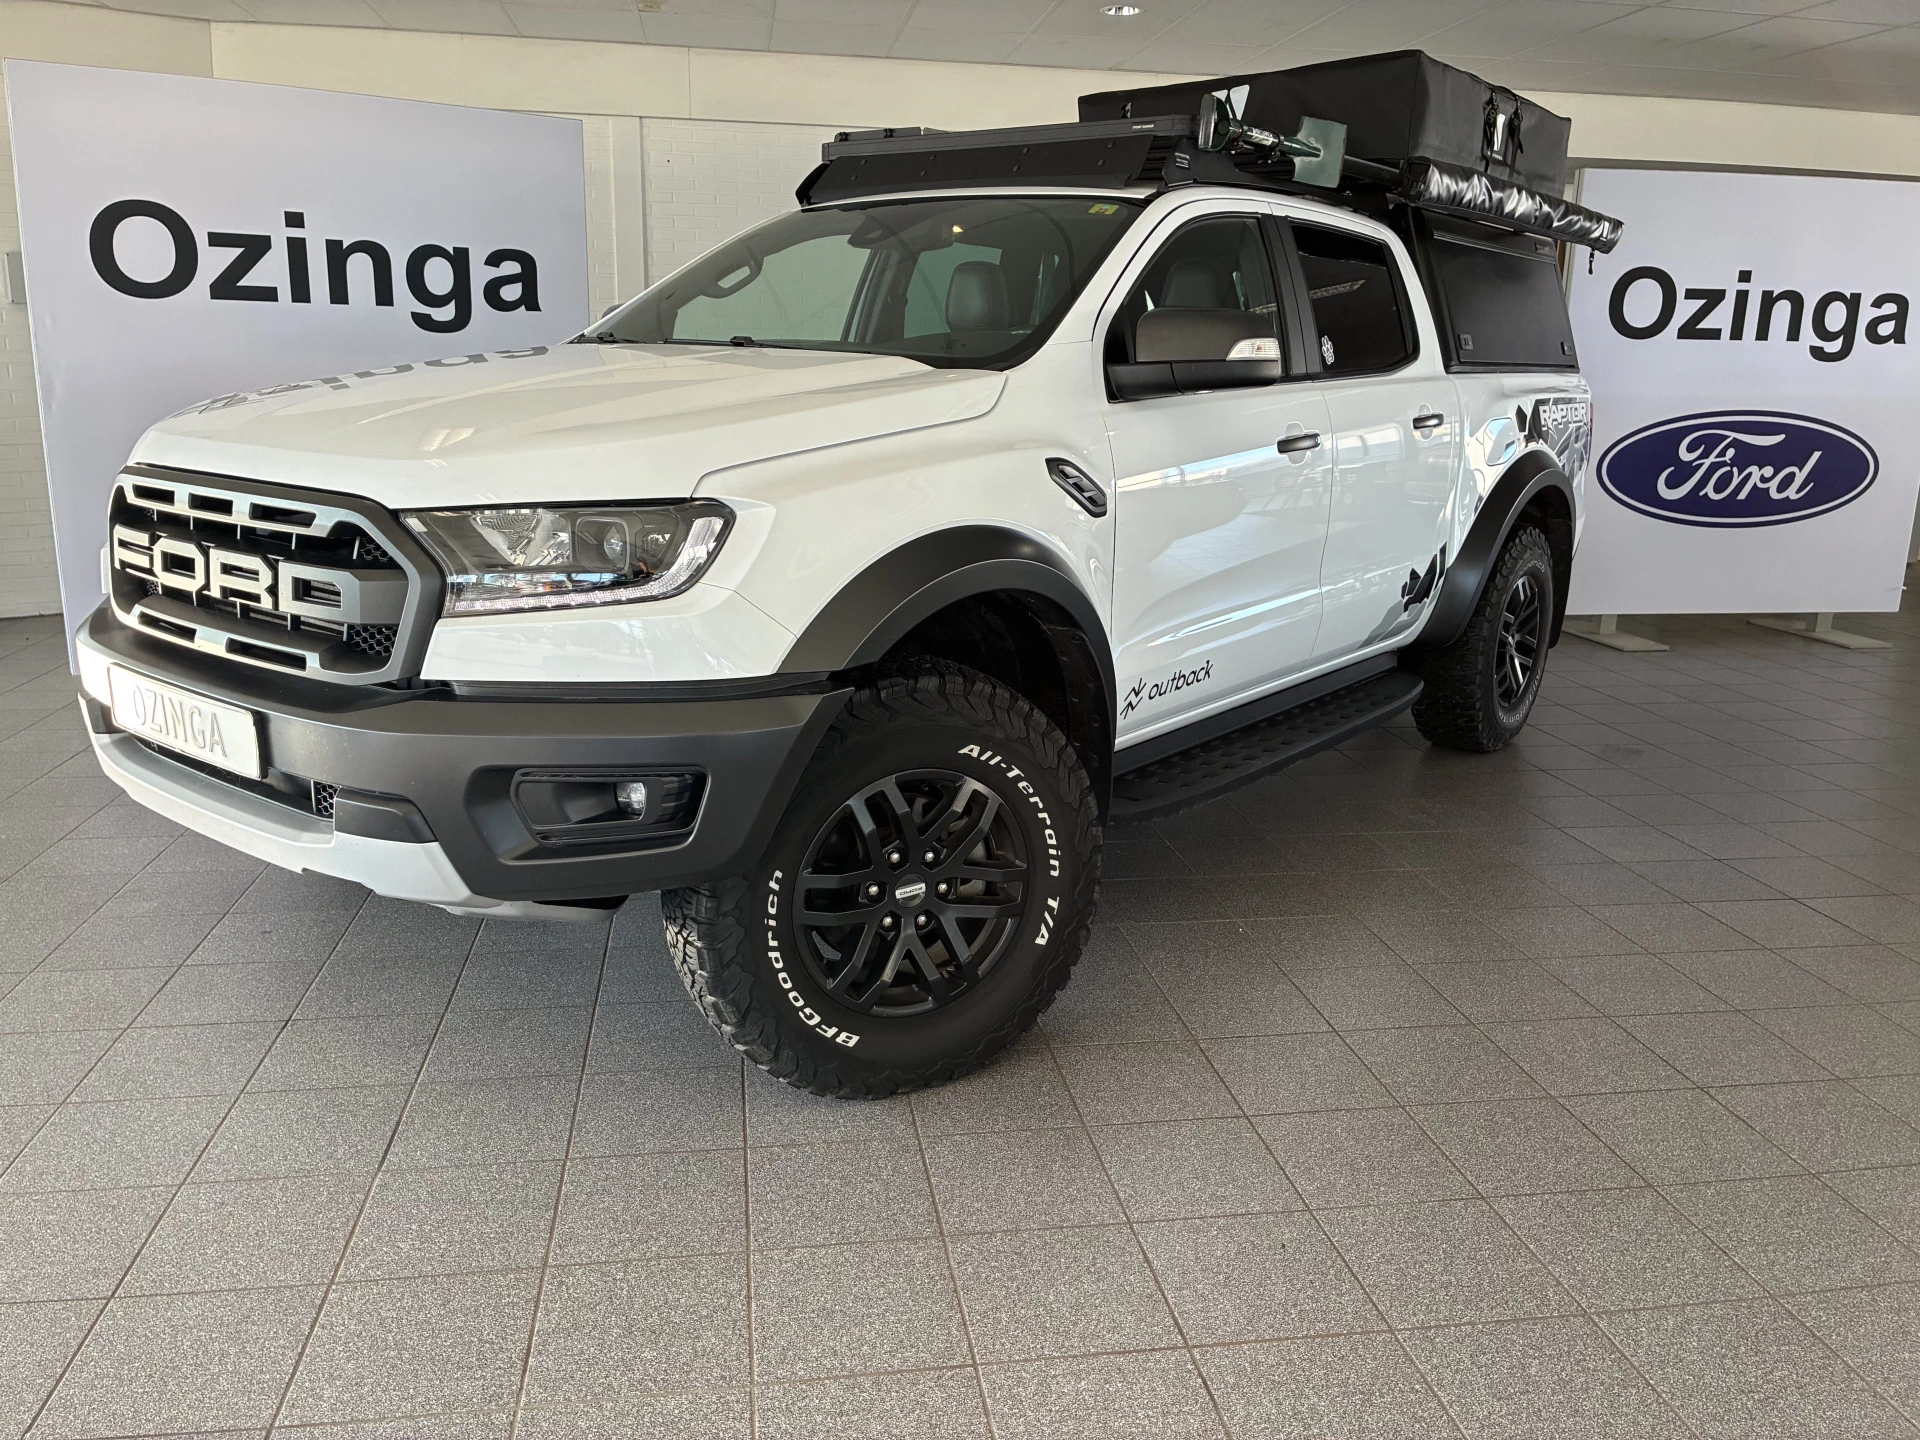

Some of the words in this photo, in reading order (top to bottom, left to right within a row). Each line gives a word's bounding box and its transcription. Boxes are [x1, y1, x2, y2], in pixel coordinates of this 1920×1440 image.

[89, 199, 542, 333] Ozinga
[1608, 265, 1910, 362] Ozinga
[1538, 402, 1588, 434] RAPTOR
[1656, 428, 1823, 501] Ford
[113, 522, 361, 624] FORD
[131, 684, 228, 759] OZINGA
[1148, 659, 1214, 700] outback
[957, 742, 1061, 878] All-Terrain
[1033, 895, 1061, 946] T/A
[763, 868, 861, 1049] BFGoodrich
